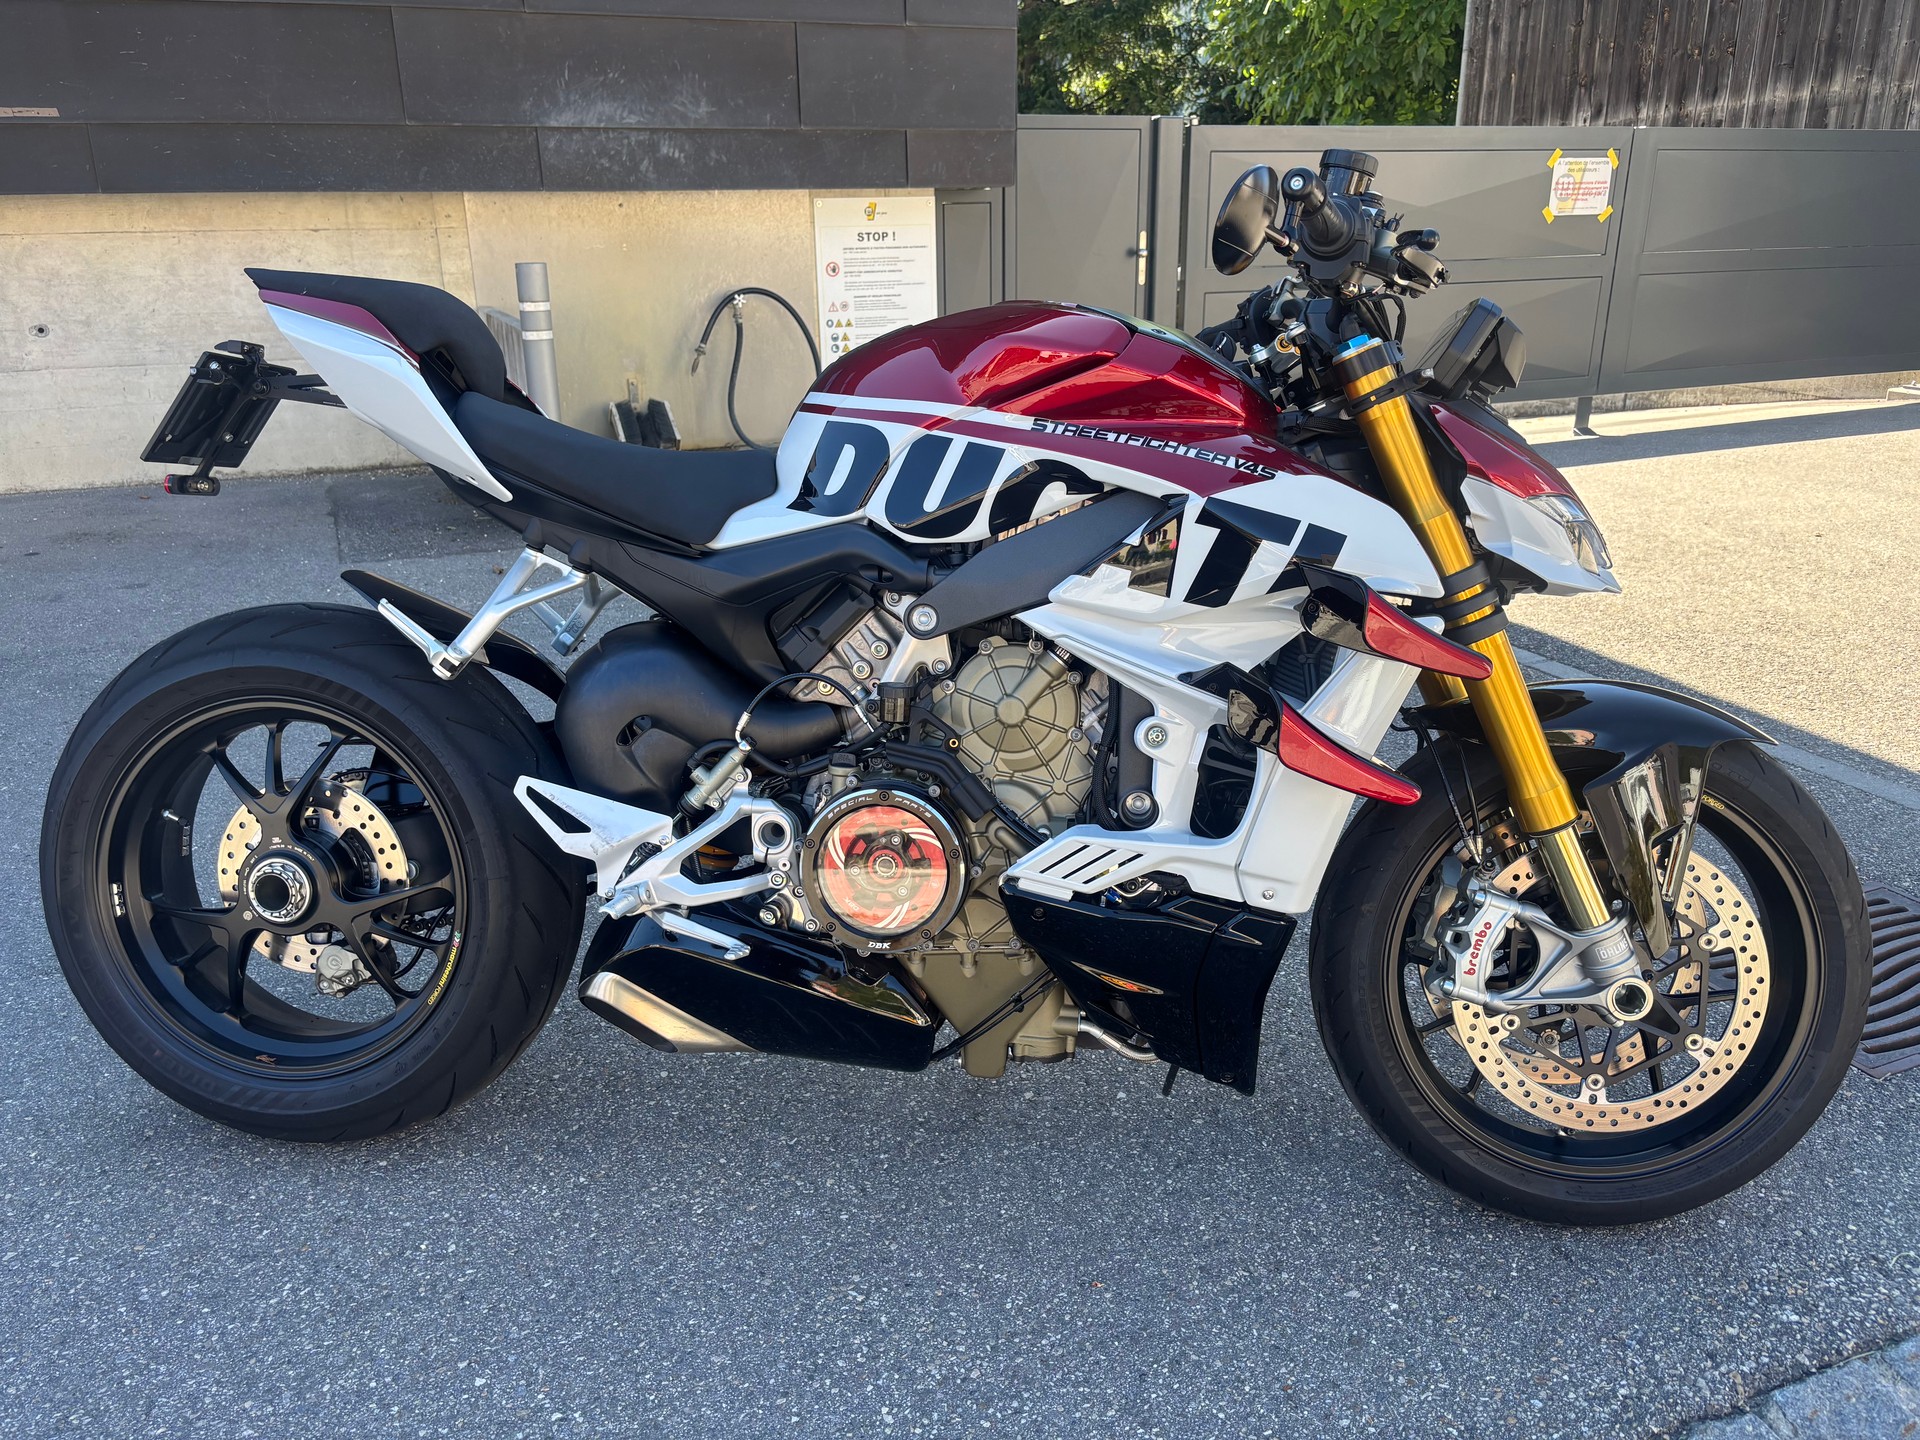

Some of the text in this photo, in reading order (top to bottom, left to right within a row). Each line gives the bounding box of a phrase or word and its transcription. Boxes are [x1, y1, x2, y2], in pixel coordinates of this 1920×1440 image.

[857, 231, 889, 242] STOP
[1030, 417, 1231, 467] STREETFIGHTER
[827, 796, 933, 820] SPECIAL PARTS
[1701, 794, 1725, 810] FORGED
[867, 941, 892, 950] DBK
[1463, 921, 1493, 976] brembo
[1599, 938, 1629, 960] ÖHLINS
[427, 946, 458, 1006] marchesini FORGED
